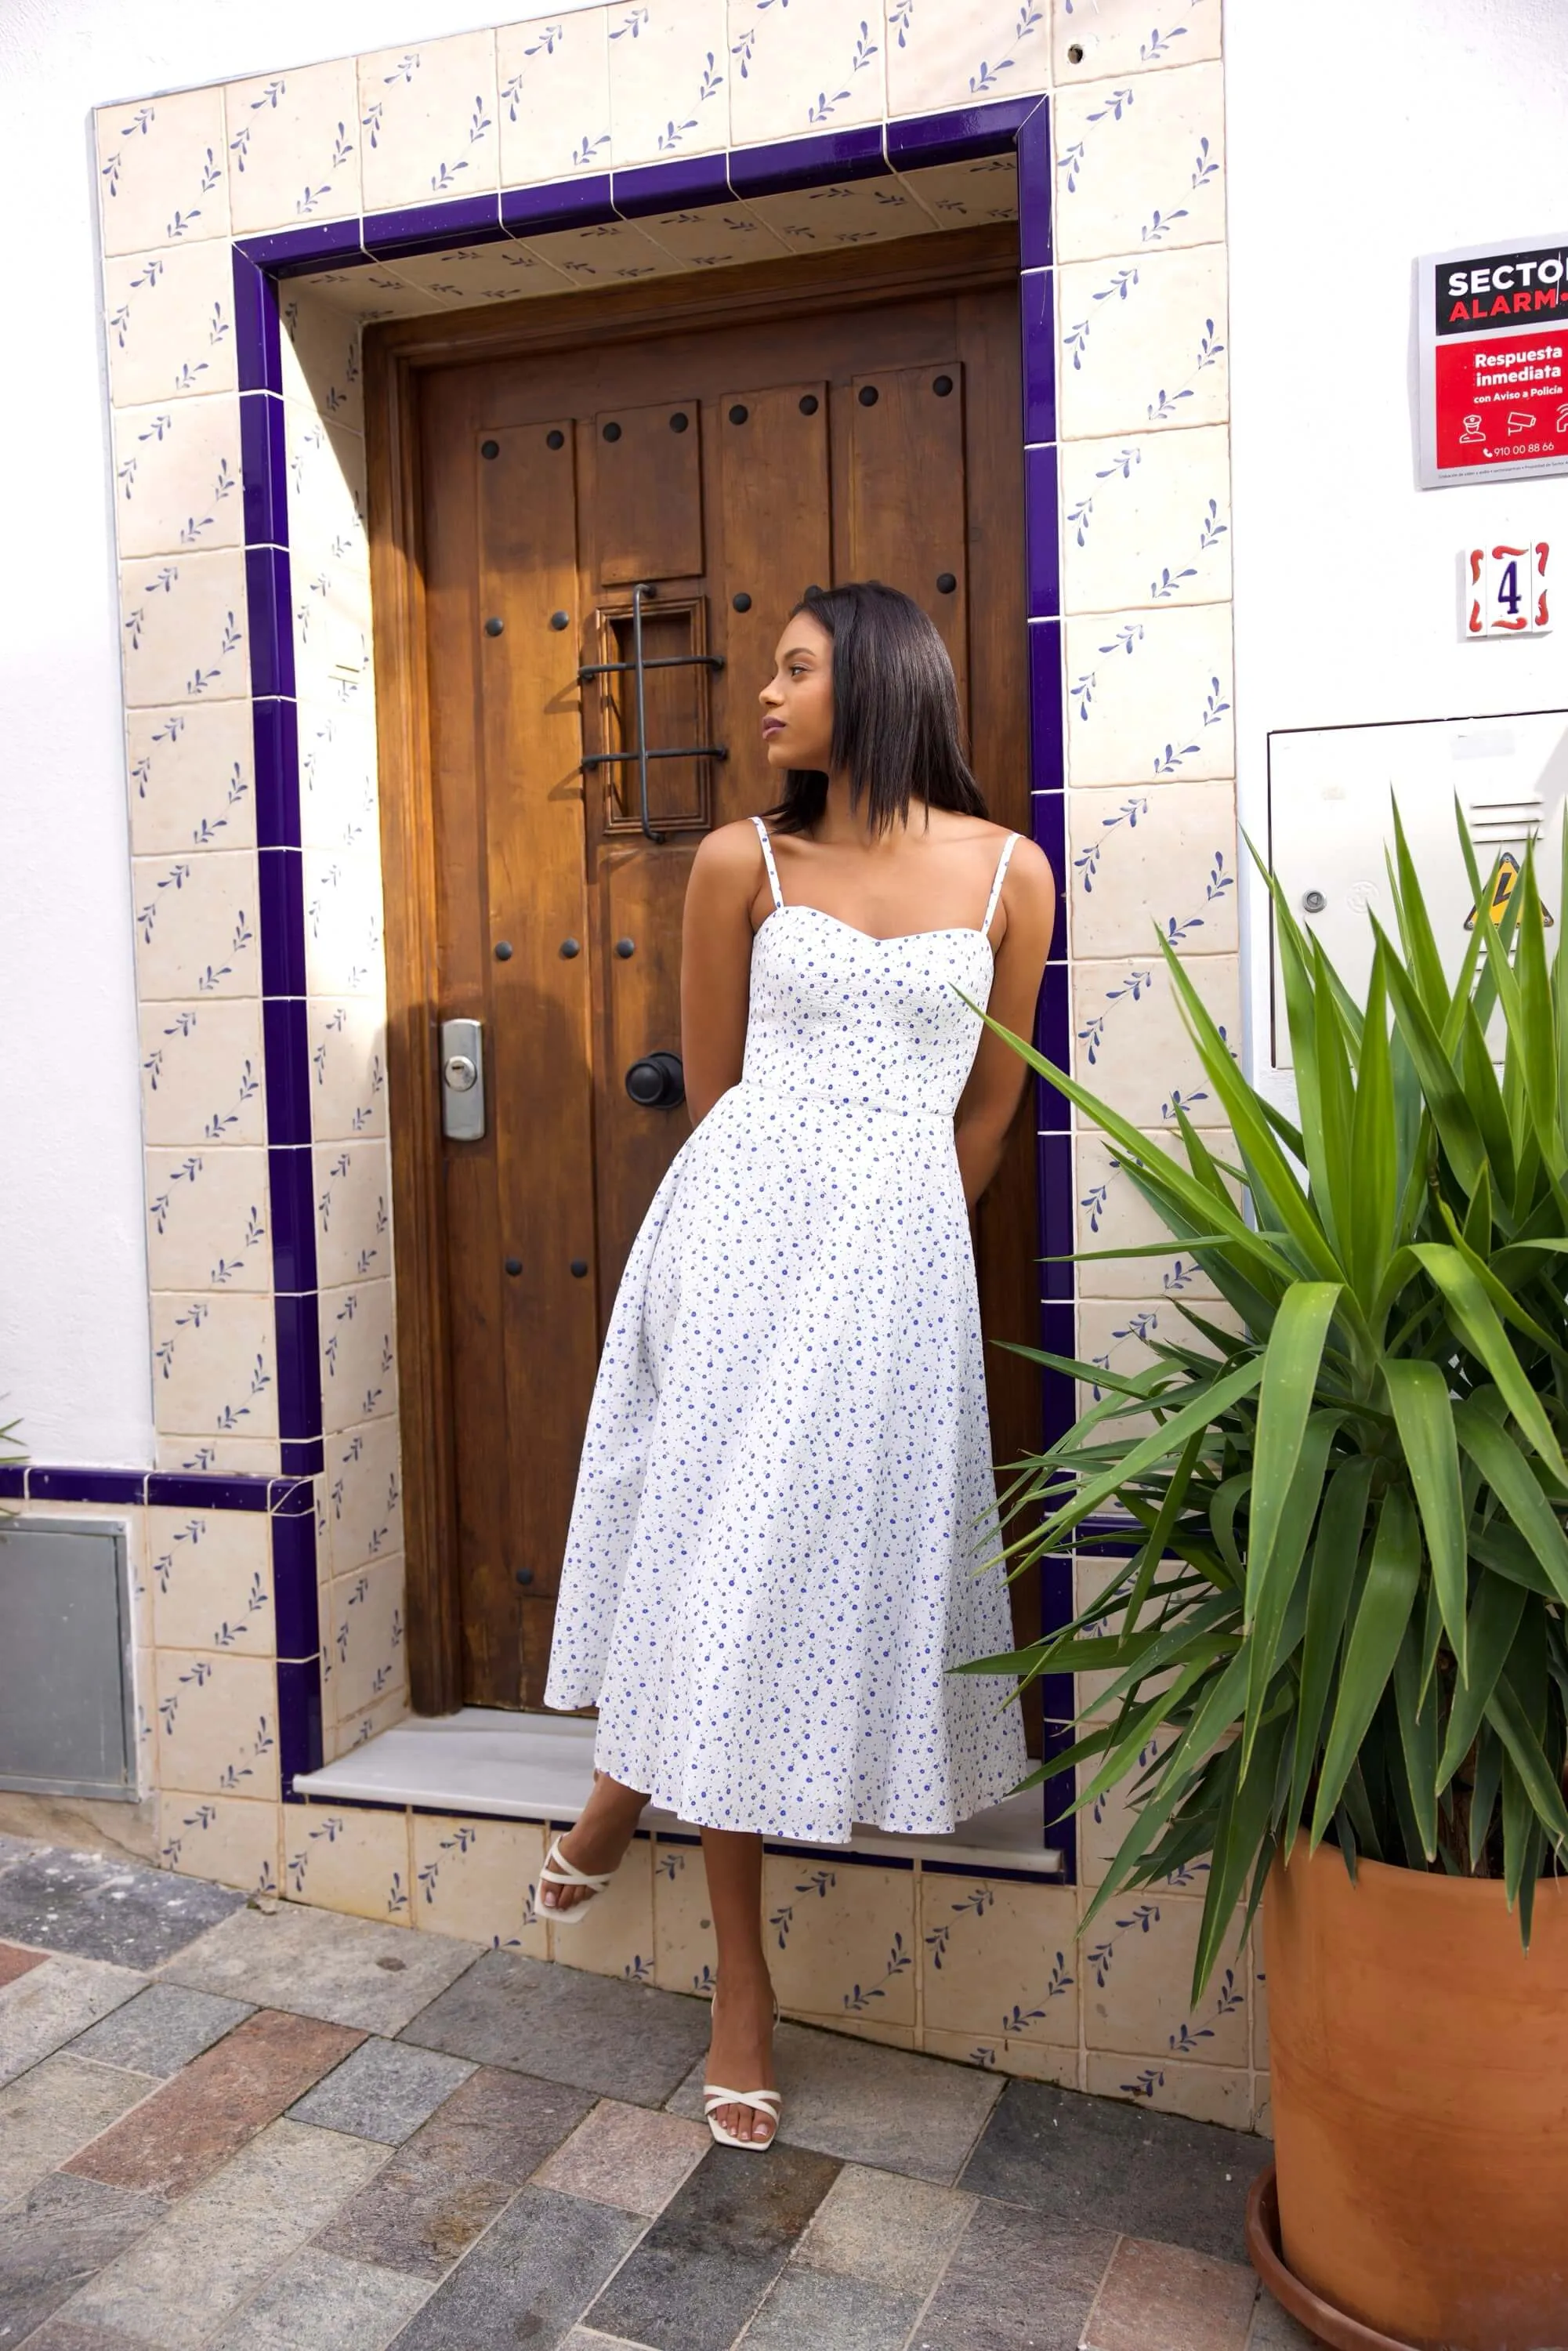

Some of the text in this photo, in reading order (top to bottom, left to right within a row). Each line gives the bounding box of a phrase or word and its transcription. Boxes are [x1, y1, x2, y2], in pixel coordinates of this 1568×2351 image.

[1448, 257, 1568, 296] SECTO
[1475, 346, 1563, 368] Respuesta
[1476, 365, 1562, 387] inmediata
[1473, 395, 1491, 404] con
[1493, 391, 1520, 401] Aviso
[1494, 441, 1555, 457] 910 00 88 66
[1497, 560, 1522, 614] 4
